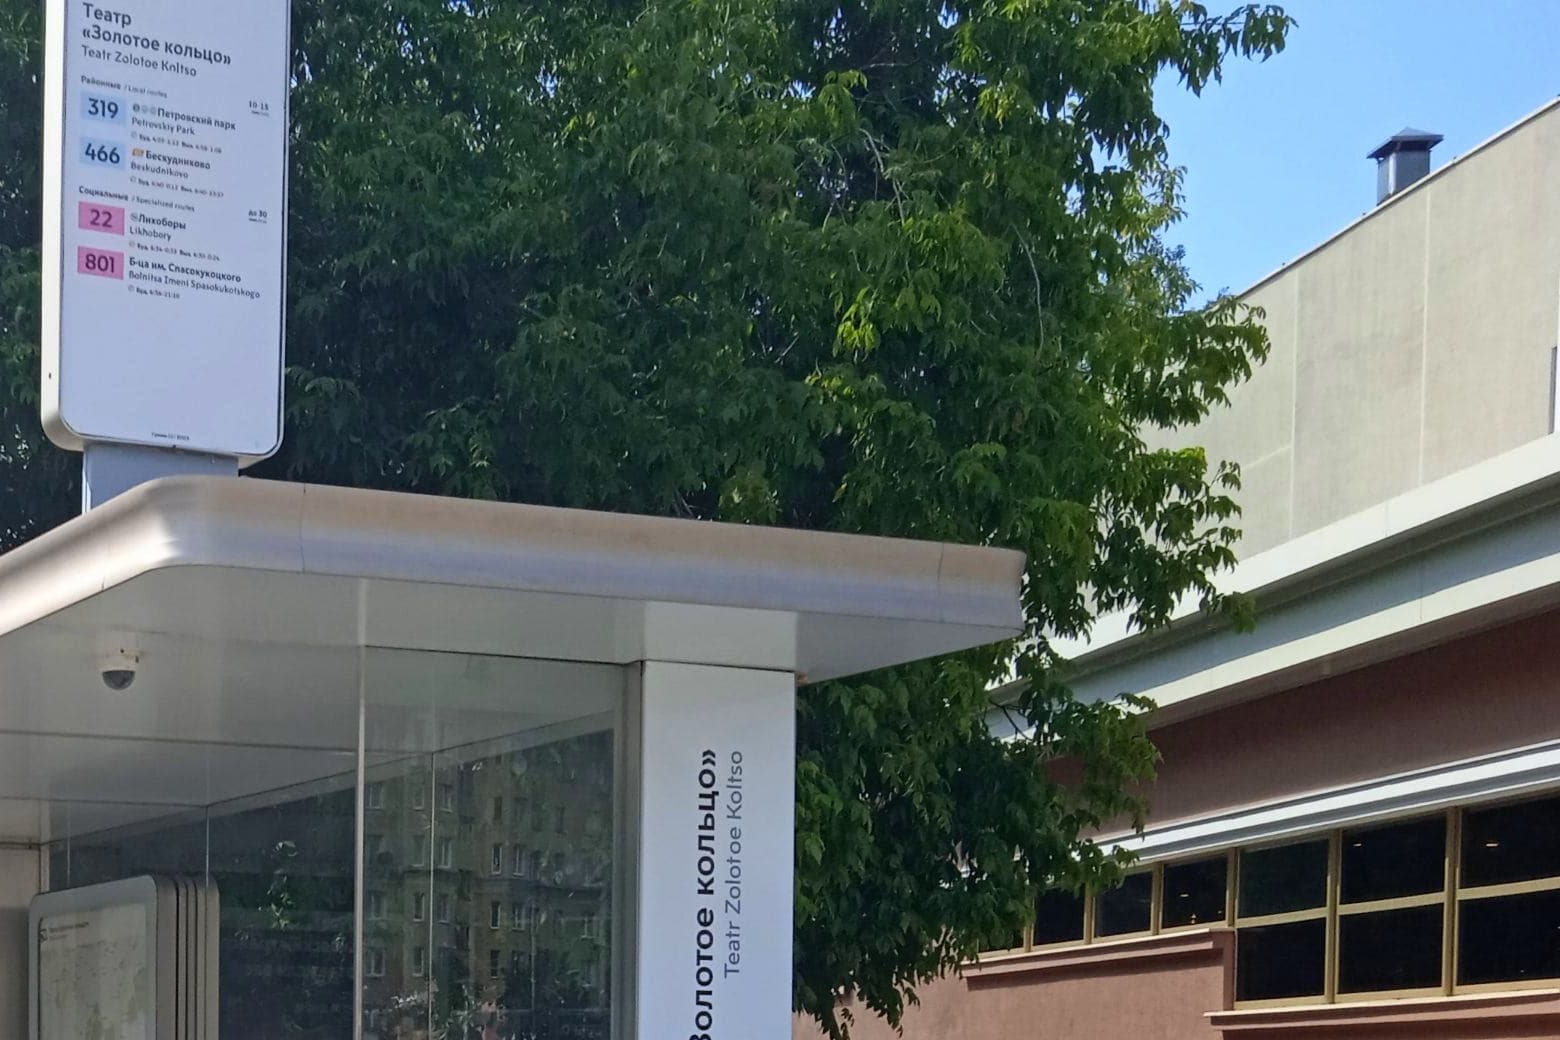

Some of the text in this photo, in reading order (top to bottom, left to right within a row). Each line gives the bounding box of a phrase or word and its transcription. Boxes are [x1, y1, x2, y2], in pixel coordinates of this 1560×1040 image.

[82, 2, 132, 28] Театр
[82, 24, 232, 67] «Золотое кольцо»
[81, 45, 197, 77] Teatr Zolotoe Koltso
[88, 97, 119, 119] 319
[157, 107, 236, 131] Петровский парк
[131, 117, 196, 136] Petrovskiy Park
[85, 143, 120, 165] 466
[145, 150, 211, 170] Бескудниково
[130, 160, 189, 178] Beskudnikovo
[79, 185, 128, 201] Социальные
[89, 208, 113, 228] 22
[138, 214, 186, 230] Лихоборы
[129, 226, 171, 242] Likhobory
[84, 253, 116, 274] 801
[129, 257, 150, 270] Б-ца
[168, 263, 242, 283] Спасокукоцкого
[697, 748, 721, 895] кольцо»
[724, 750, 743, 979] Teatr Zolotoe Koltso
